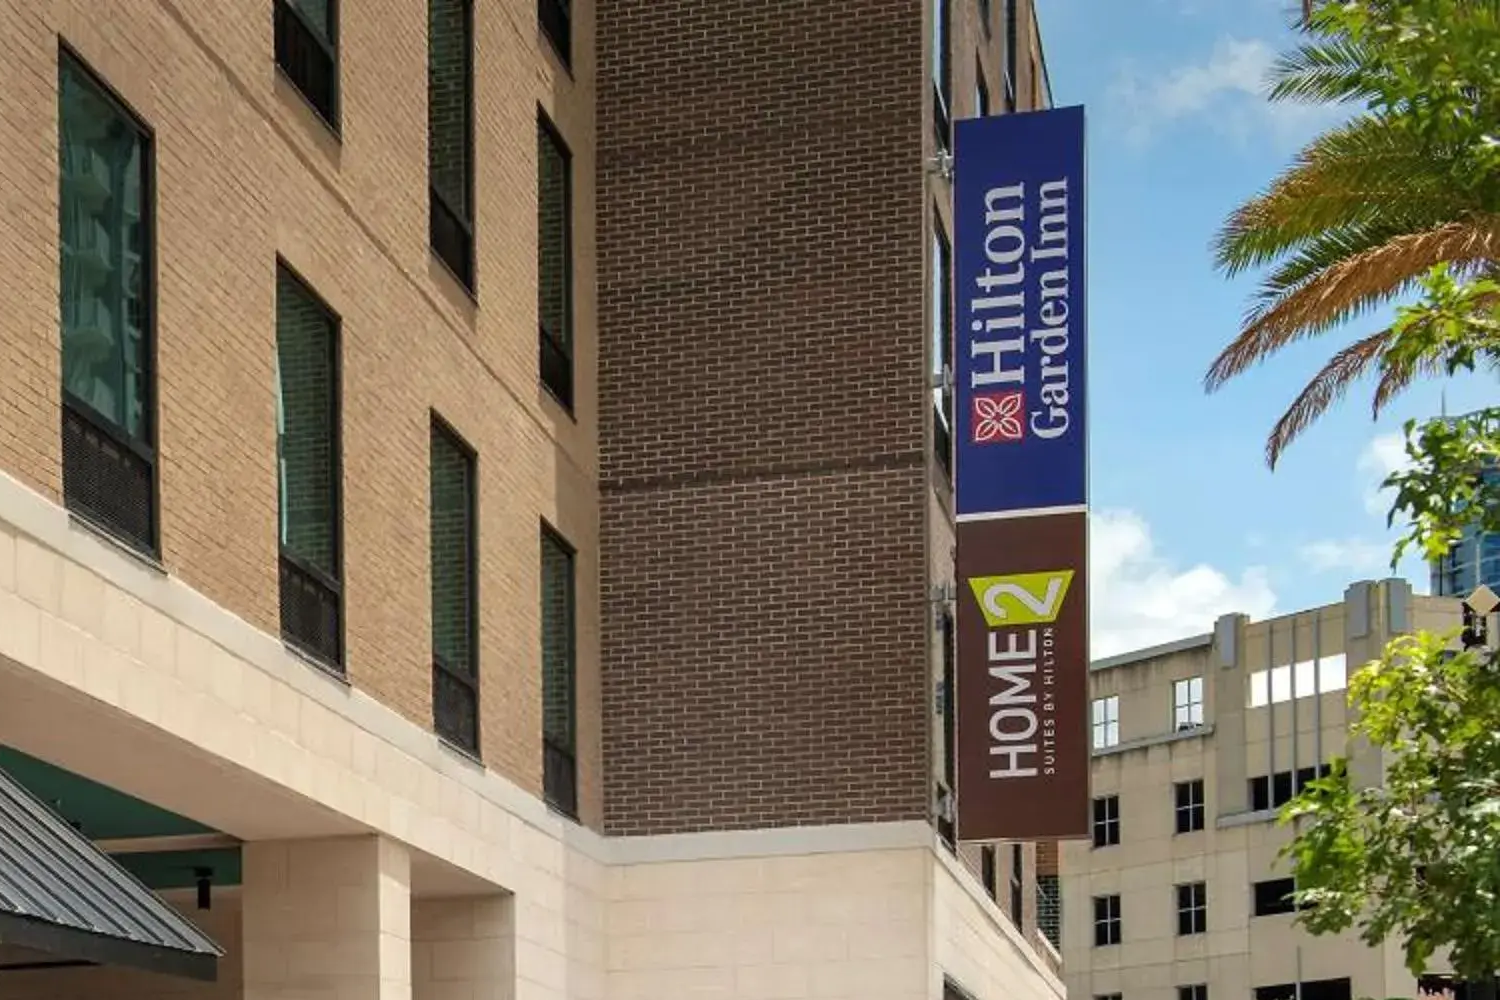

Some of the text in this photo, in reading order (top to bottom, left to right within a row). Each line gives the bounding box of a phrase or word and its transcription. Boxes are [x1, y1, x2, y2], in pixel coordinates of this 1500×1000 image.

[971, 181, 1025, 388] Hilton
[1031, 176, 1069, 439] Garden Inn
[983, 577, 1062, 779] HOME 2
[1043, 627, 1056, 775] SUITES BY HILTON
